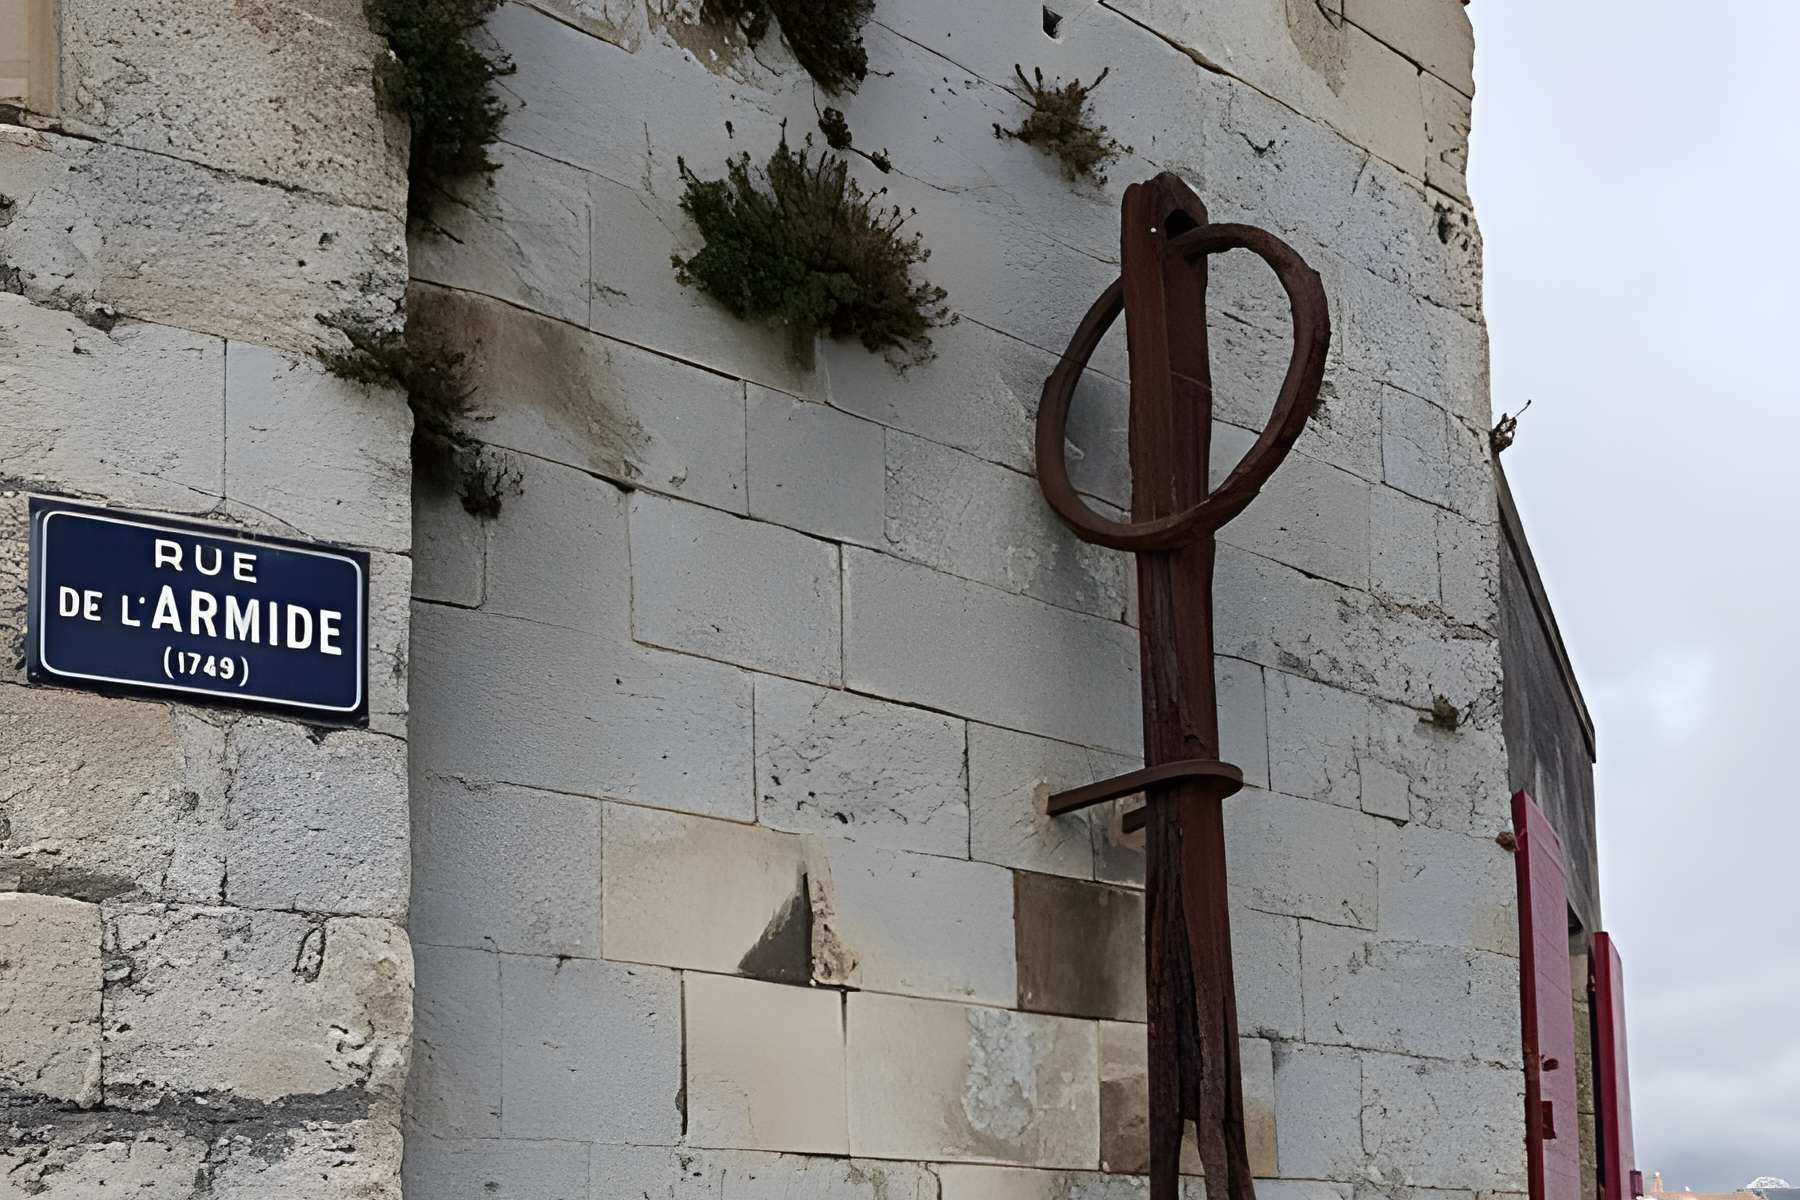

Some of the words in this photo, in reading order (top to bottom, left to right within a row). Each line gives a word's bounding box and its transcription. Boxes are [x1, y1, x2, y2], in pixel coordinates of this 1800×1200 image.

[155, 538, 257, 583] RUE
[59, 585, 103, 621] DE
[163, 646, 249, 687] (1749)
